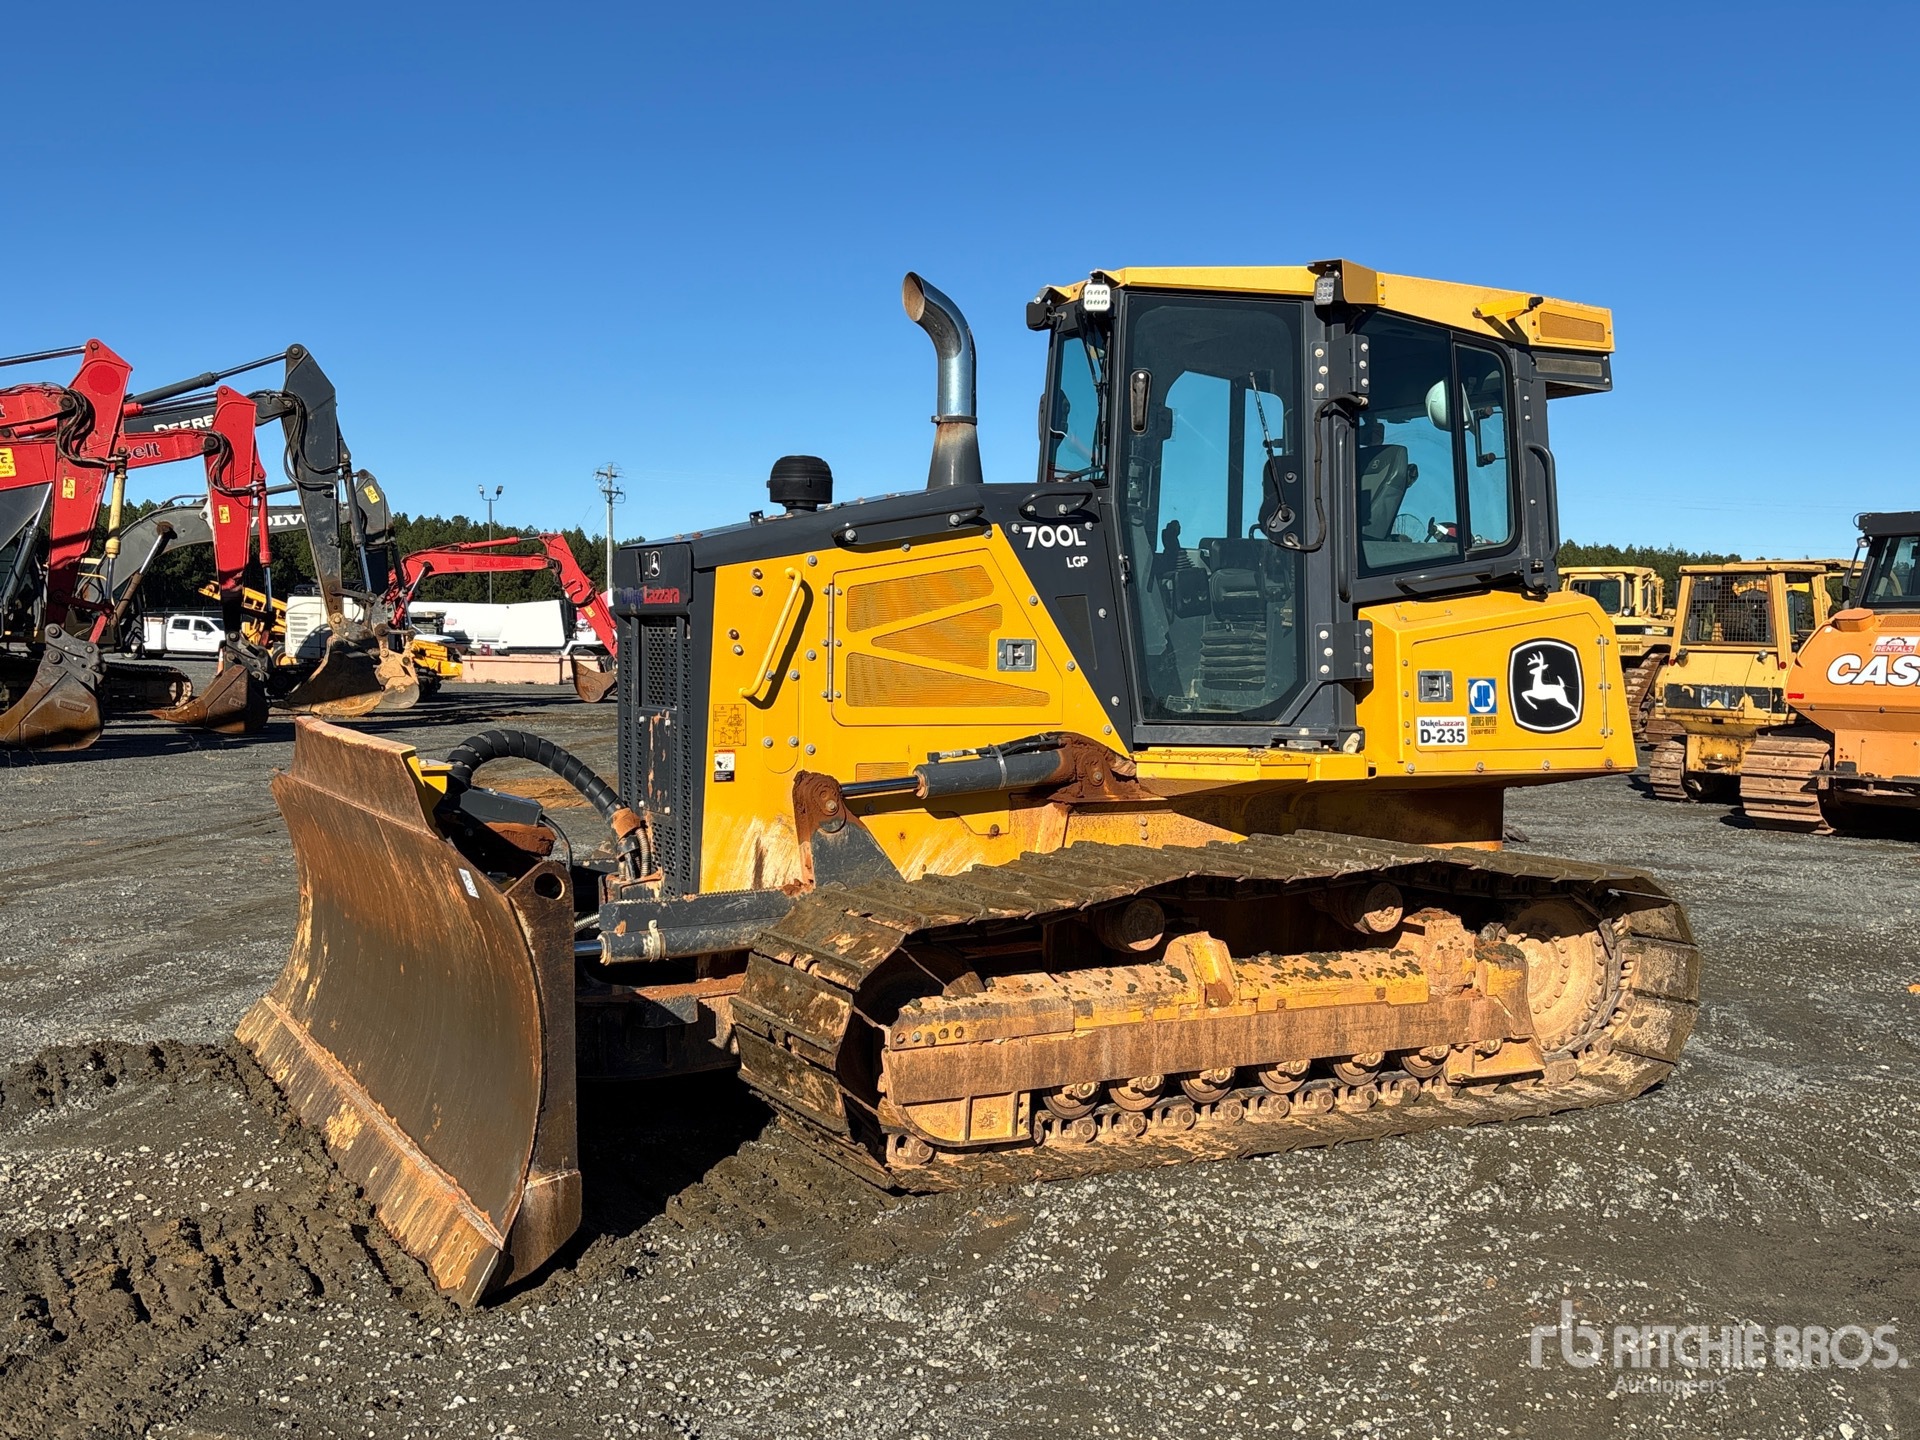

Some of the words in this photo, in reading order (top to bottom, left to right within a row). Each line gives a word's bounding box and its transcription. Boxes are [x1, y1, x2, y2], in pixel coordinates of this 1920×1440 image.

[127, 441, 161, 460] elt
[1021, 524, 1087, 549] 700L
[1065, 555, 1089, 568] LGP
[1874, 645, 1914, 653] RENTALS
[1826, 653, 1920, 687] CAS
[1420, 728, 1465, 743] D-235
